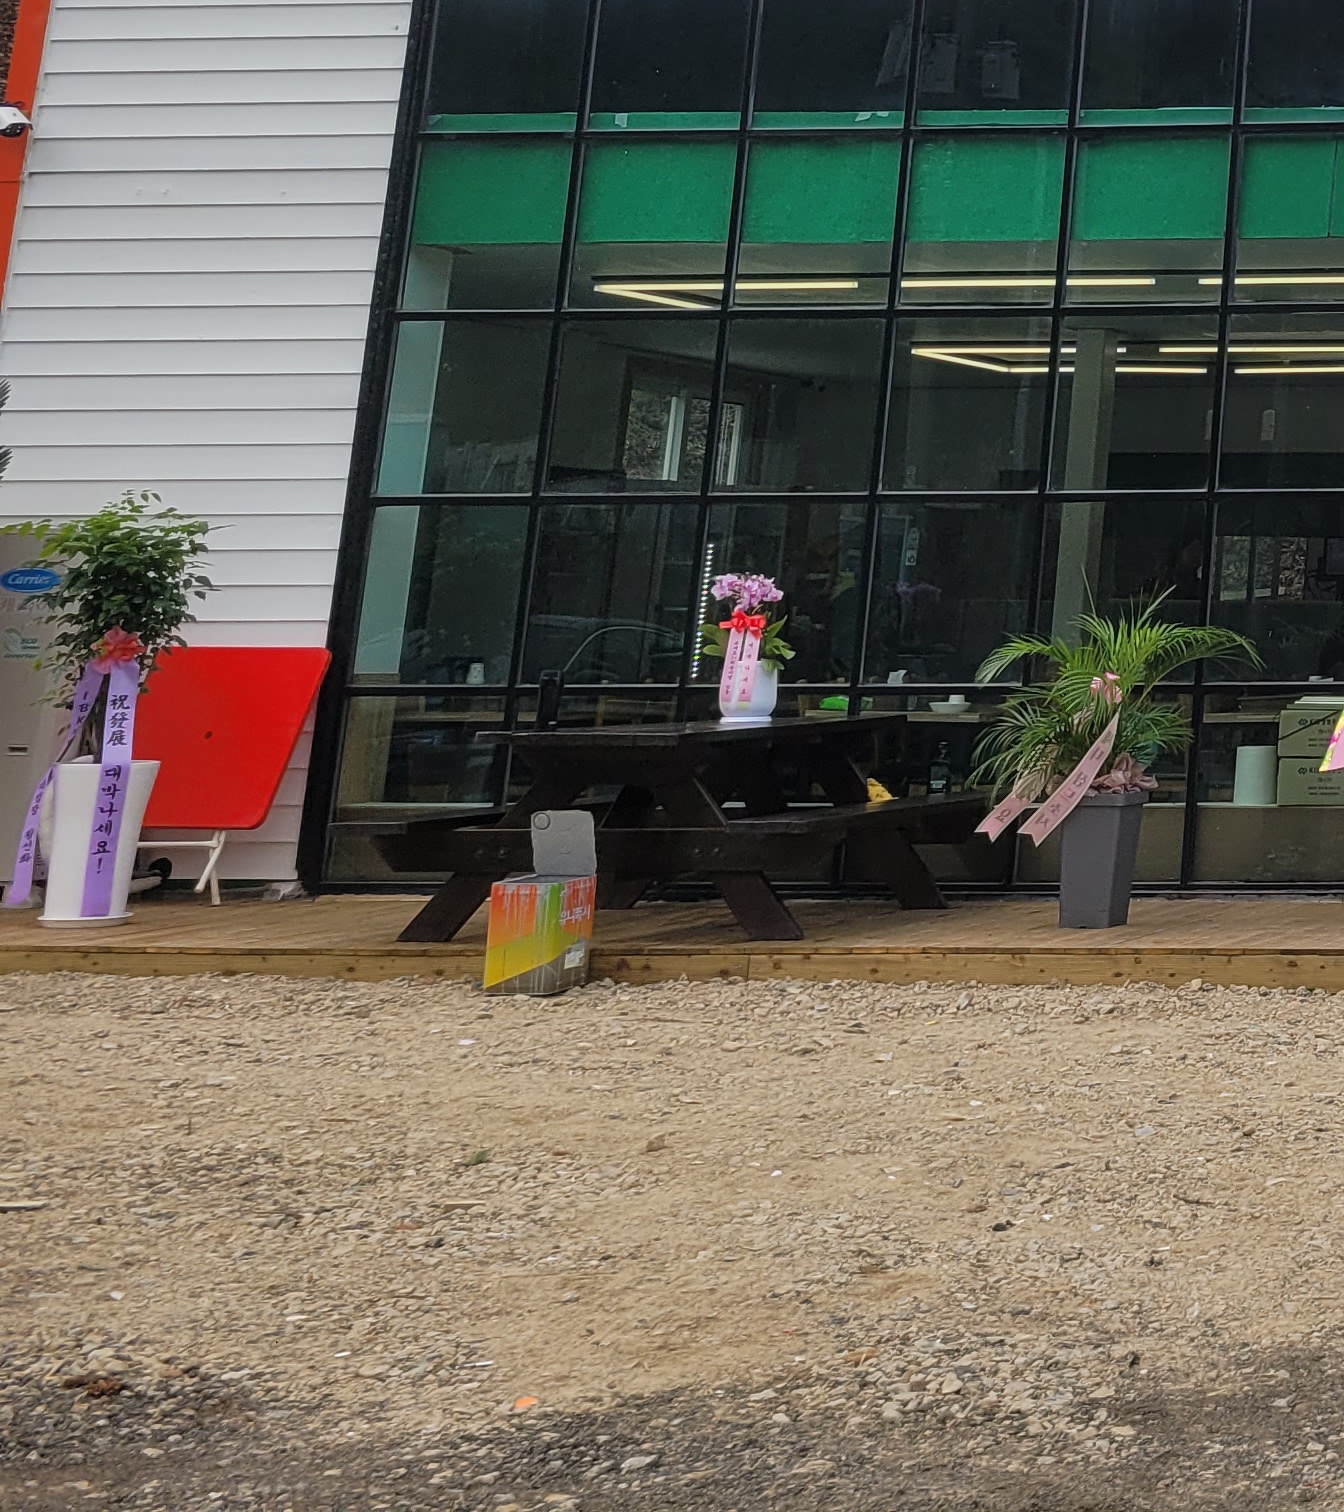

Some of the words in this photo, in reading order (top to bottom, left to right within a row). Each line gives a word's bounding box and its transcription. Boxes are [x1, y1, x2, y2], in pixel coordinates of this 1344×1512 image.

[106, 694, 131, 746] 祝發展
[91, 765, 122, 874] 대박나세요!
